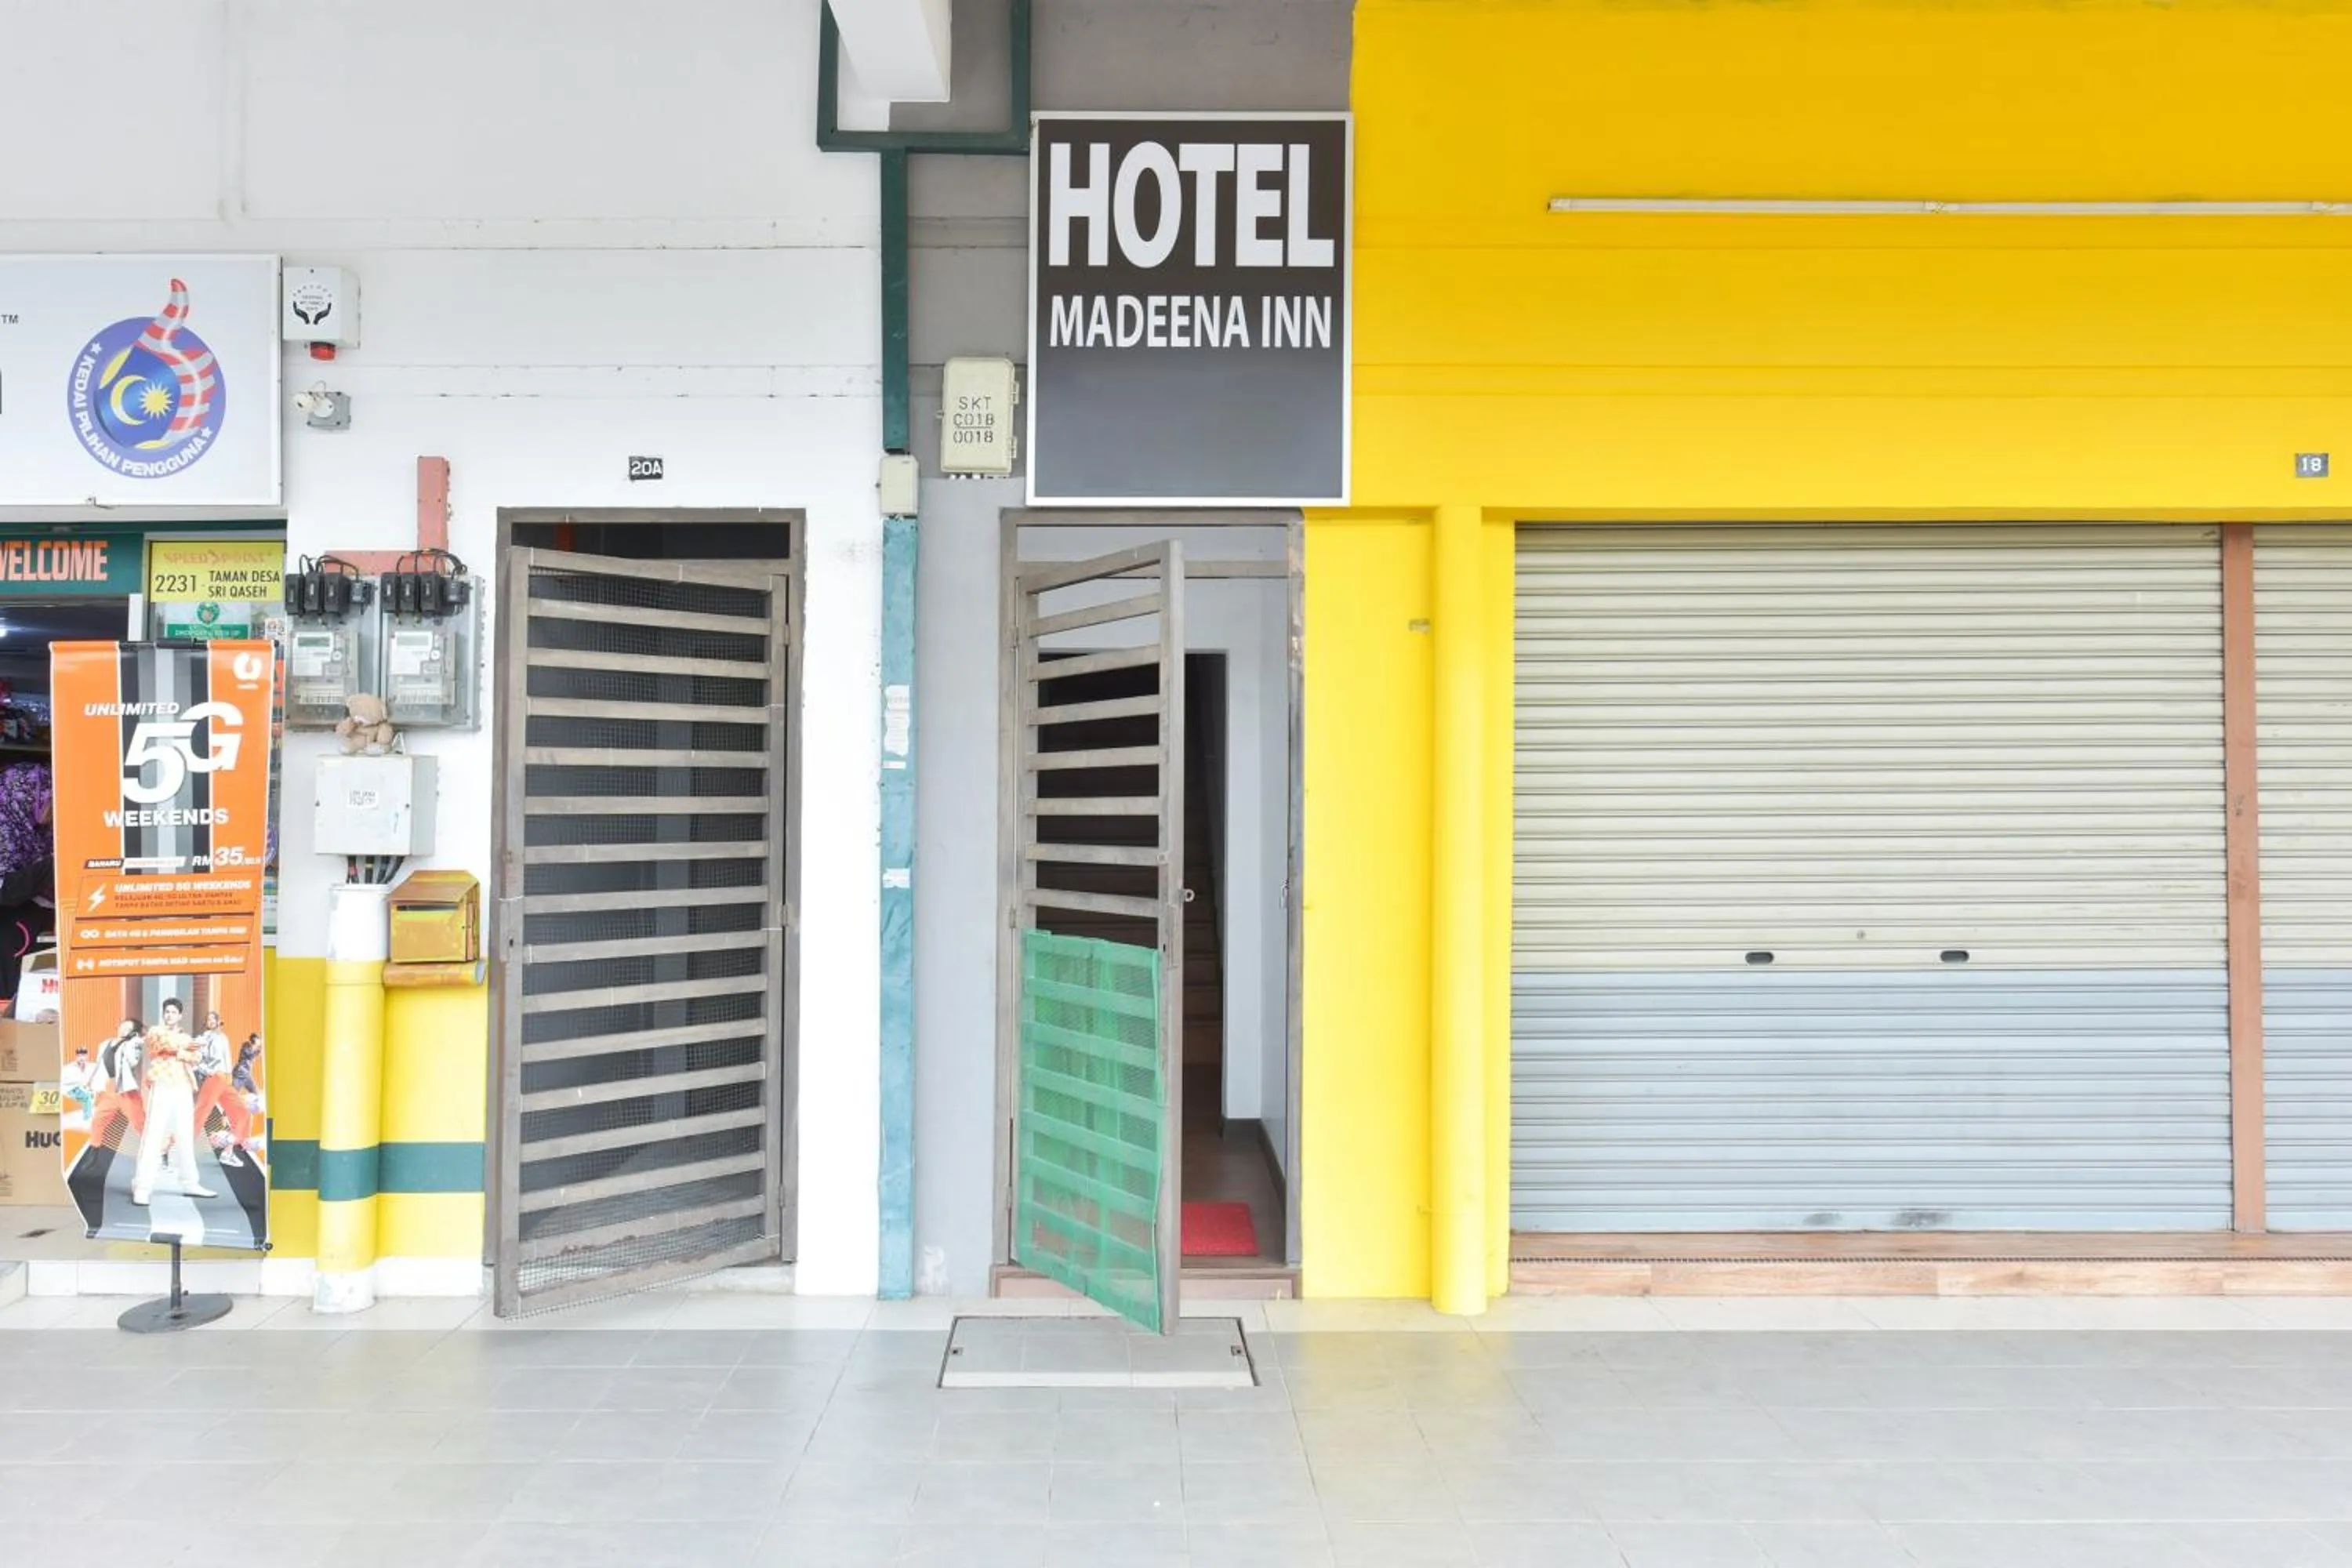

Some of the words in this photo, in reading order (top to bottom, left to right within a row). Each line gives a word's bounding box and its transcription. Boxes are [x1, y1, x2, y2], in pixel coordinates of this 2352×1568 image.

[1049, 141, 1334, 267] HOTEL
[1, 314, 19, 324] TM
[1050, 295, 1250, 348] MADEENA
[1261, 296, 1331, 348] INN
[74, 353, 96, 408] KEDAI
[959, 396, 991, 410] SKT
[76, 410, 121, 469] PILIHAN
[122, 436, 210, 477] PENGGUNA
[2302, 457, 2321, 472] 18
[631, 459, 662, 475] 20A
[154, 575, 197, 593] 2231
[209, 570, 249, 583] TAMAN
[252, 571, 281, 583] DESA
[209, 586, 227, 597] SRI
[230, 586, 267, 597] QASEH
[84, 702, 180, 716] UNLIMITED
[122, 701, 244, 804] 5G
[103, 808, 229, 827] WEEKENDS
[38, 1091, 60, 1105] 30
